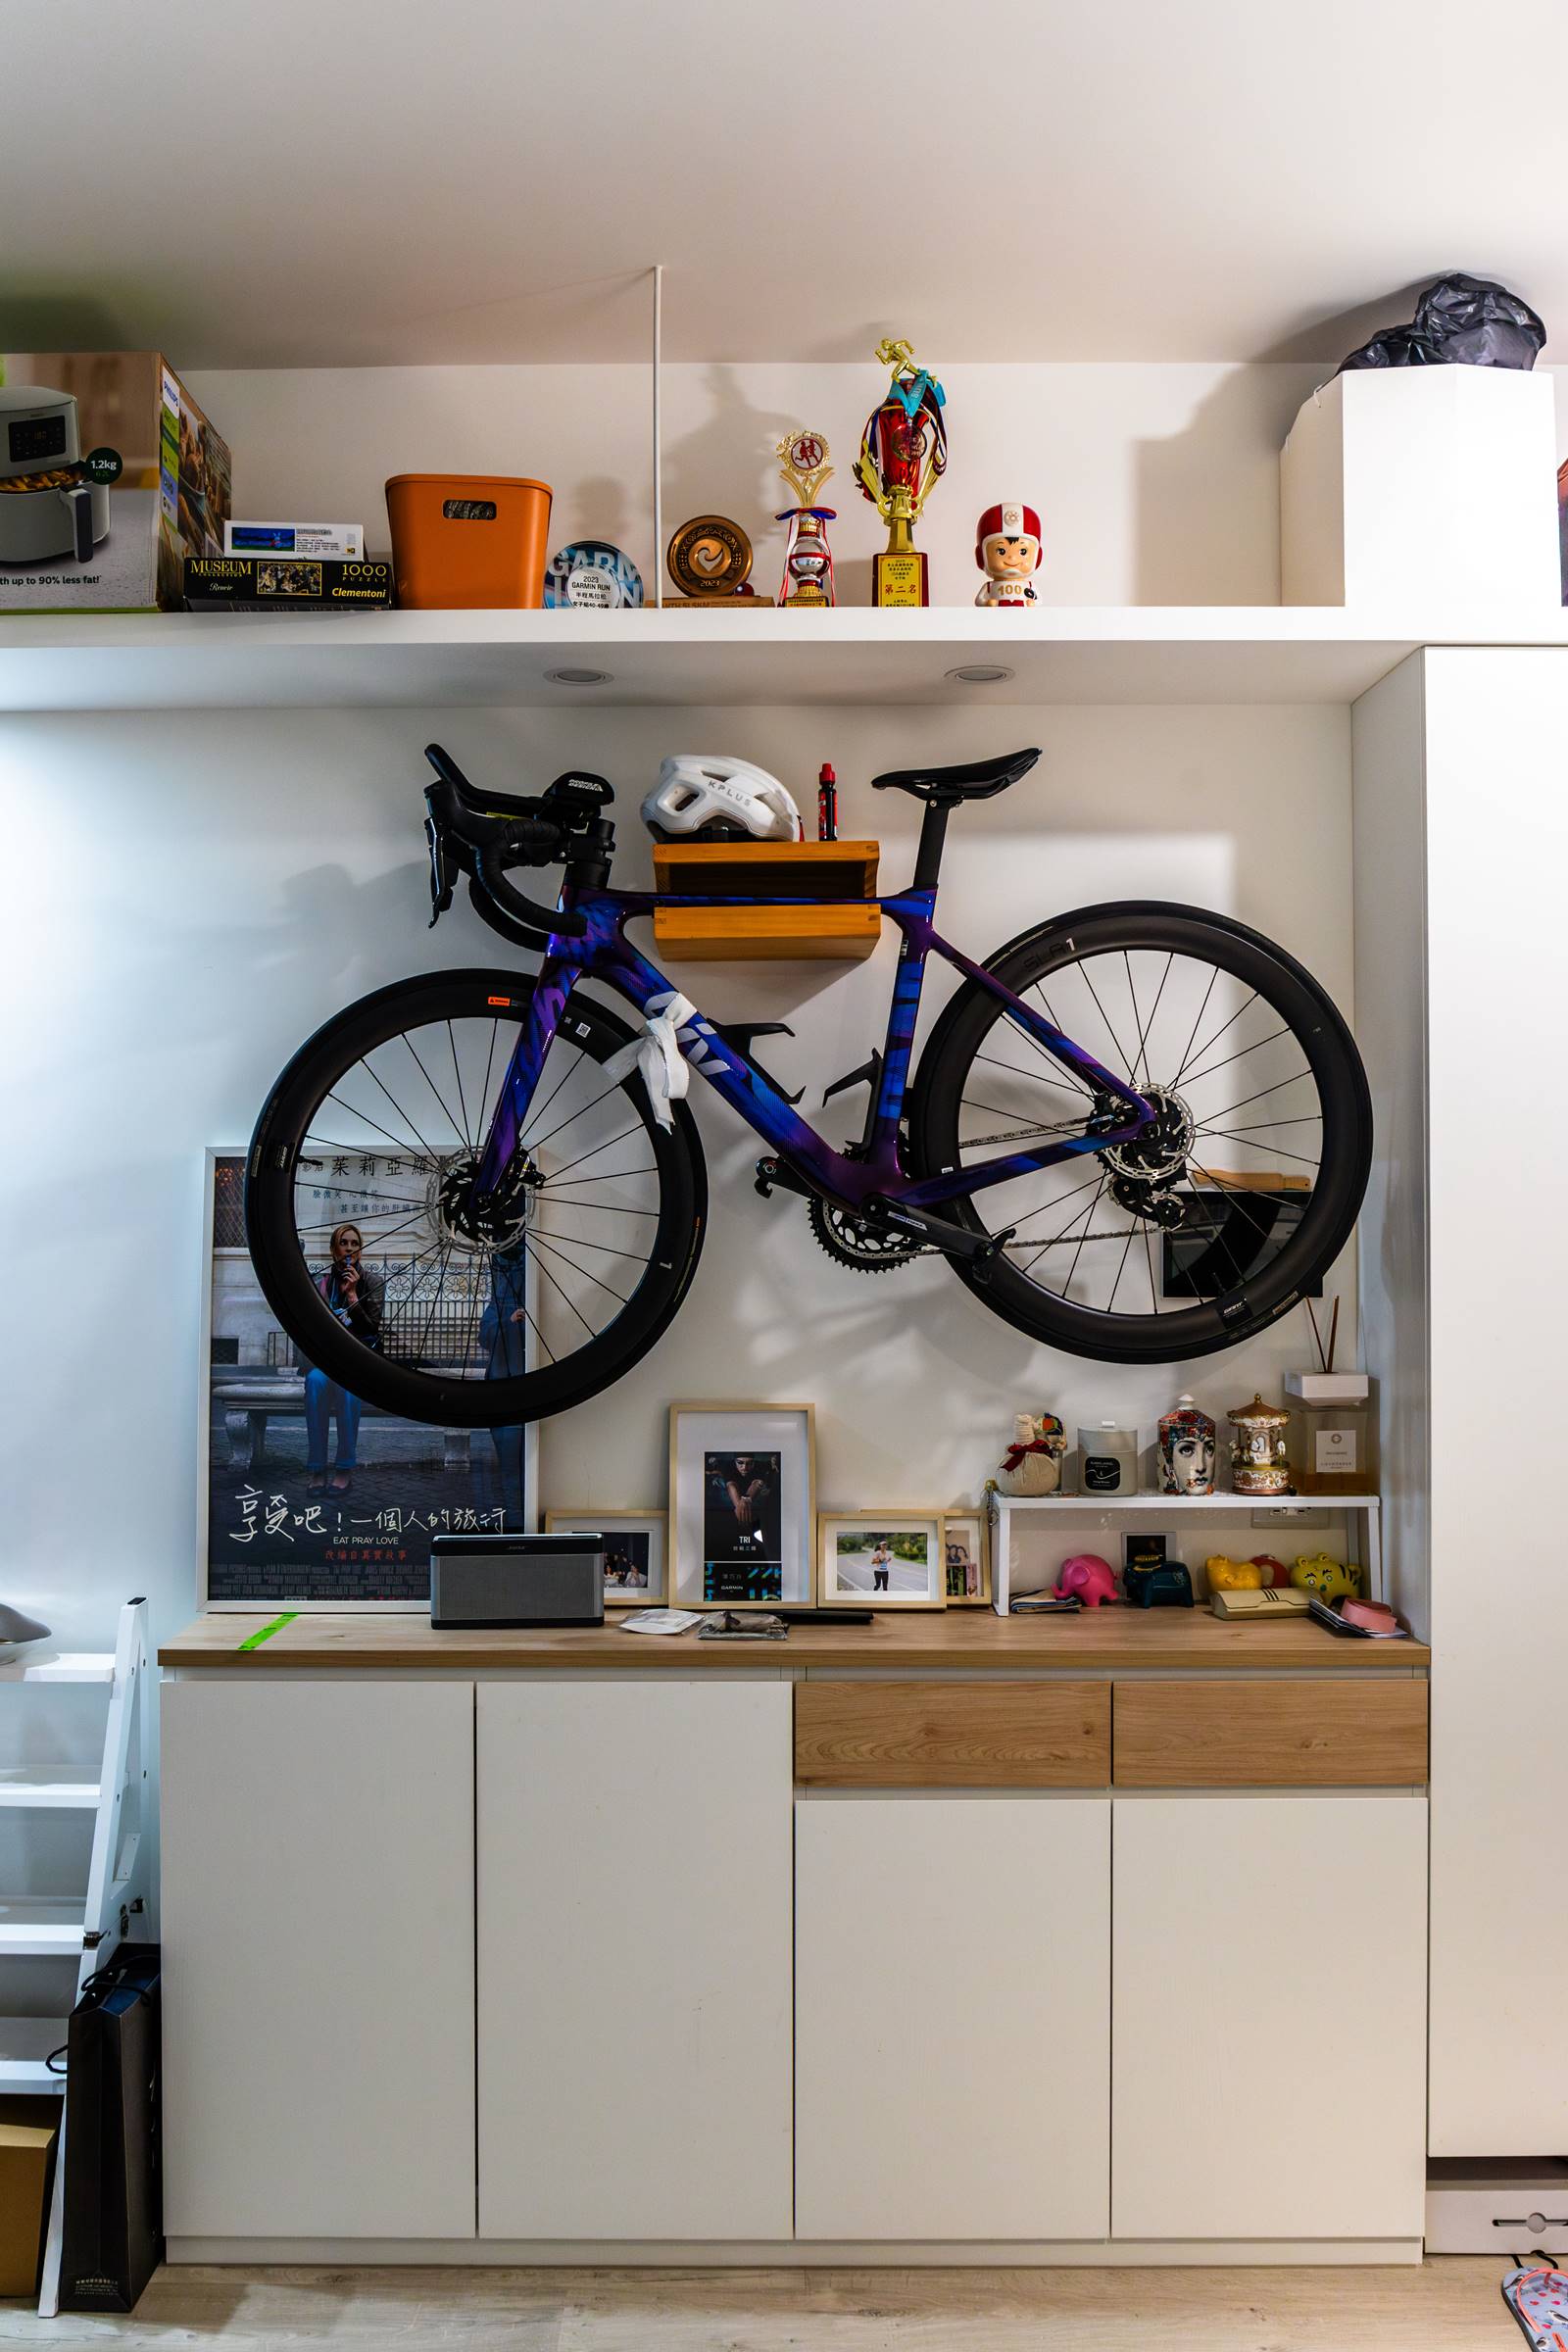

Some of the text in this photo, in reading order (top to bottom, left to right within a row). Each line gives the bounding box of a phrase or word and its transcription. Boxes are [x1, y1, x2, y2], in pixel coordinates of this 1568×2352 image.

[90, 460, 117, 470] 1.2kg
[190, 560, 252, 574] MUSEUM
[342, 564, 387, 576] 1000
[12, 577, 24, 586] up
[38, 576, 60, 585] 90%
[62, 575, 80, 584] less
[571, 581, 596, 590] GARMIN
[331, 587, 386, 598] Clementoni
[885, 583, 916, 595] 第二名
[998, 585, 1022, 596] 100
[708, 779, 752, 808] KPLUS
[739, 1536, 751, 1544] TRI
